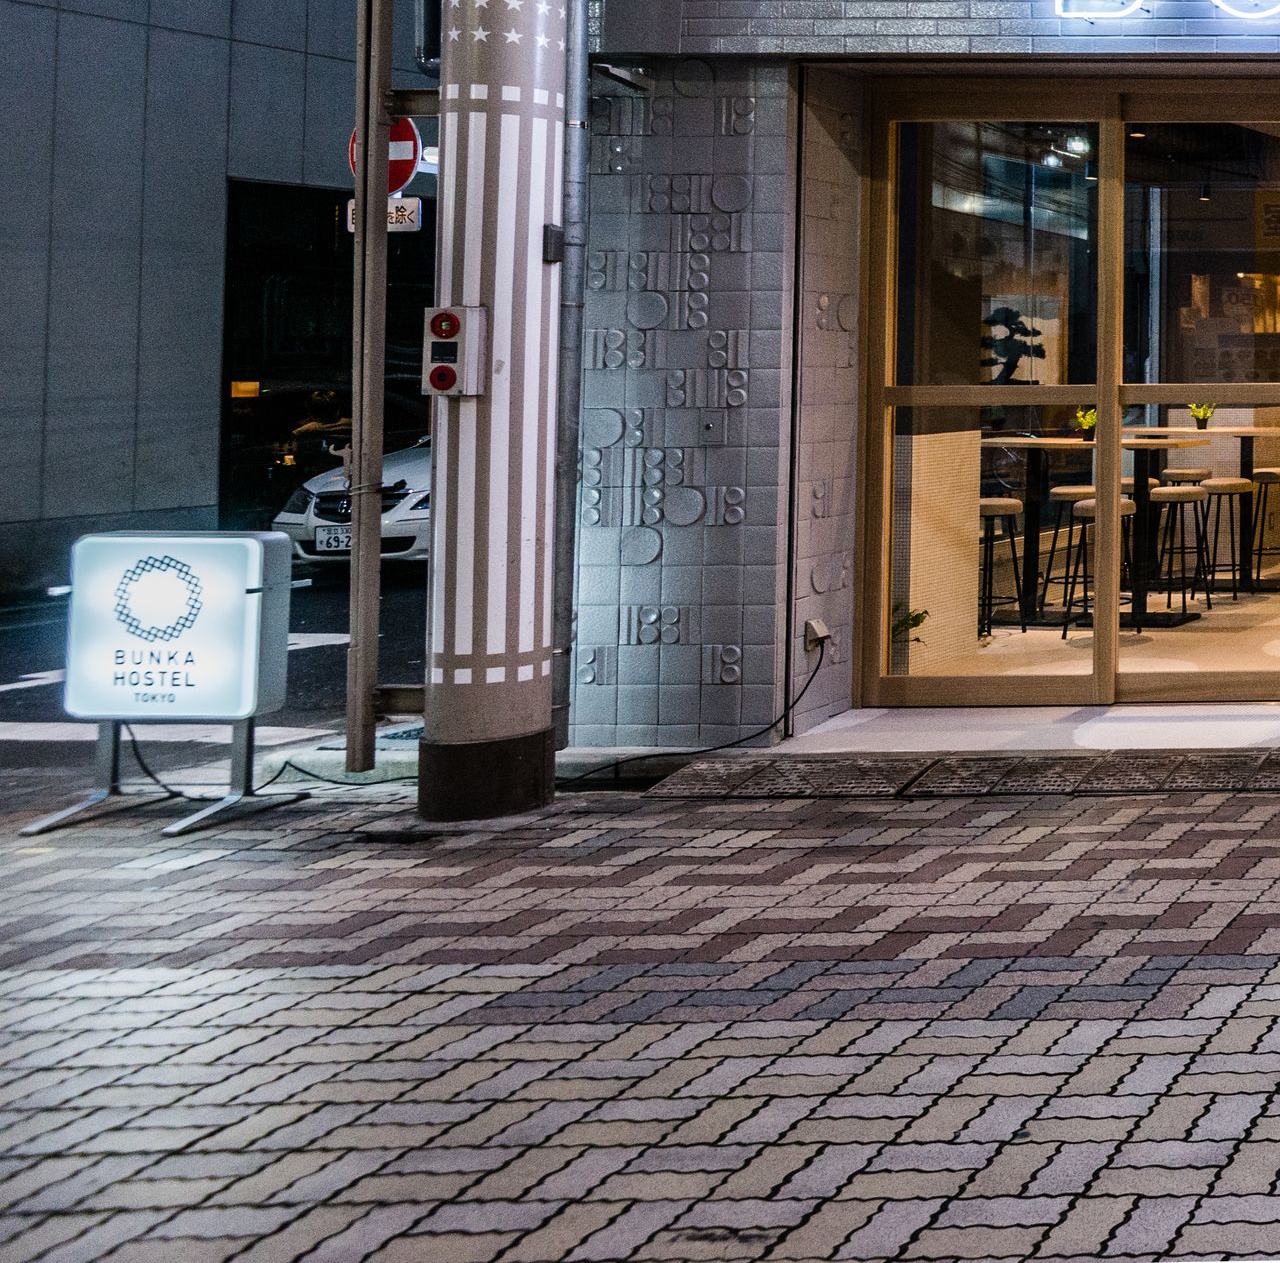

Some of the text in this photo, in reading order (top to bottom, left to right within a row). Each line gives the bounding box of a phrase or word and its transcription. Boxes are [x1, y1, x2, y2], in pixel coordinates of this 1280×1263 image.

[326, 535, 352, 549] 69-2
[114, 649, 196, 665] BUNKA
[114, 671, 196, 687] HOSTEL
[134, 692, 176, 703] TOKYO
